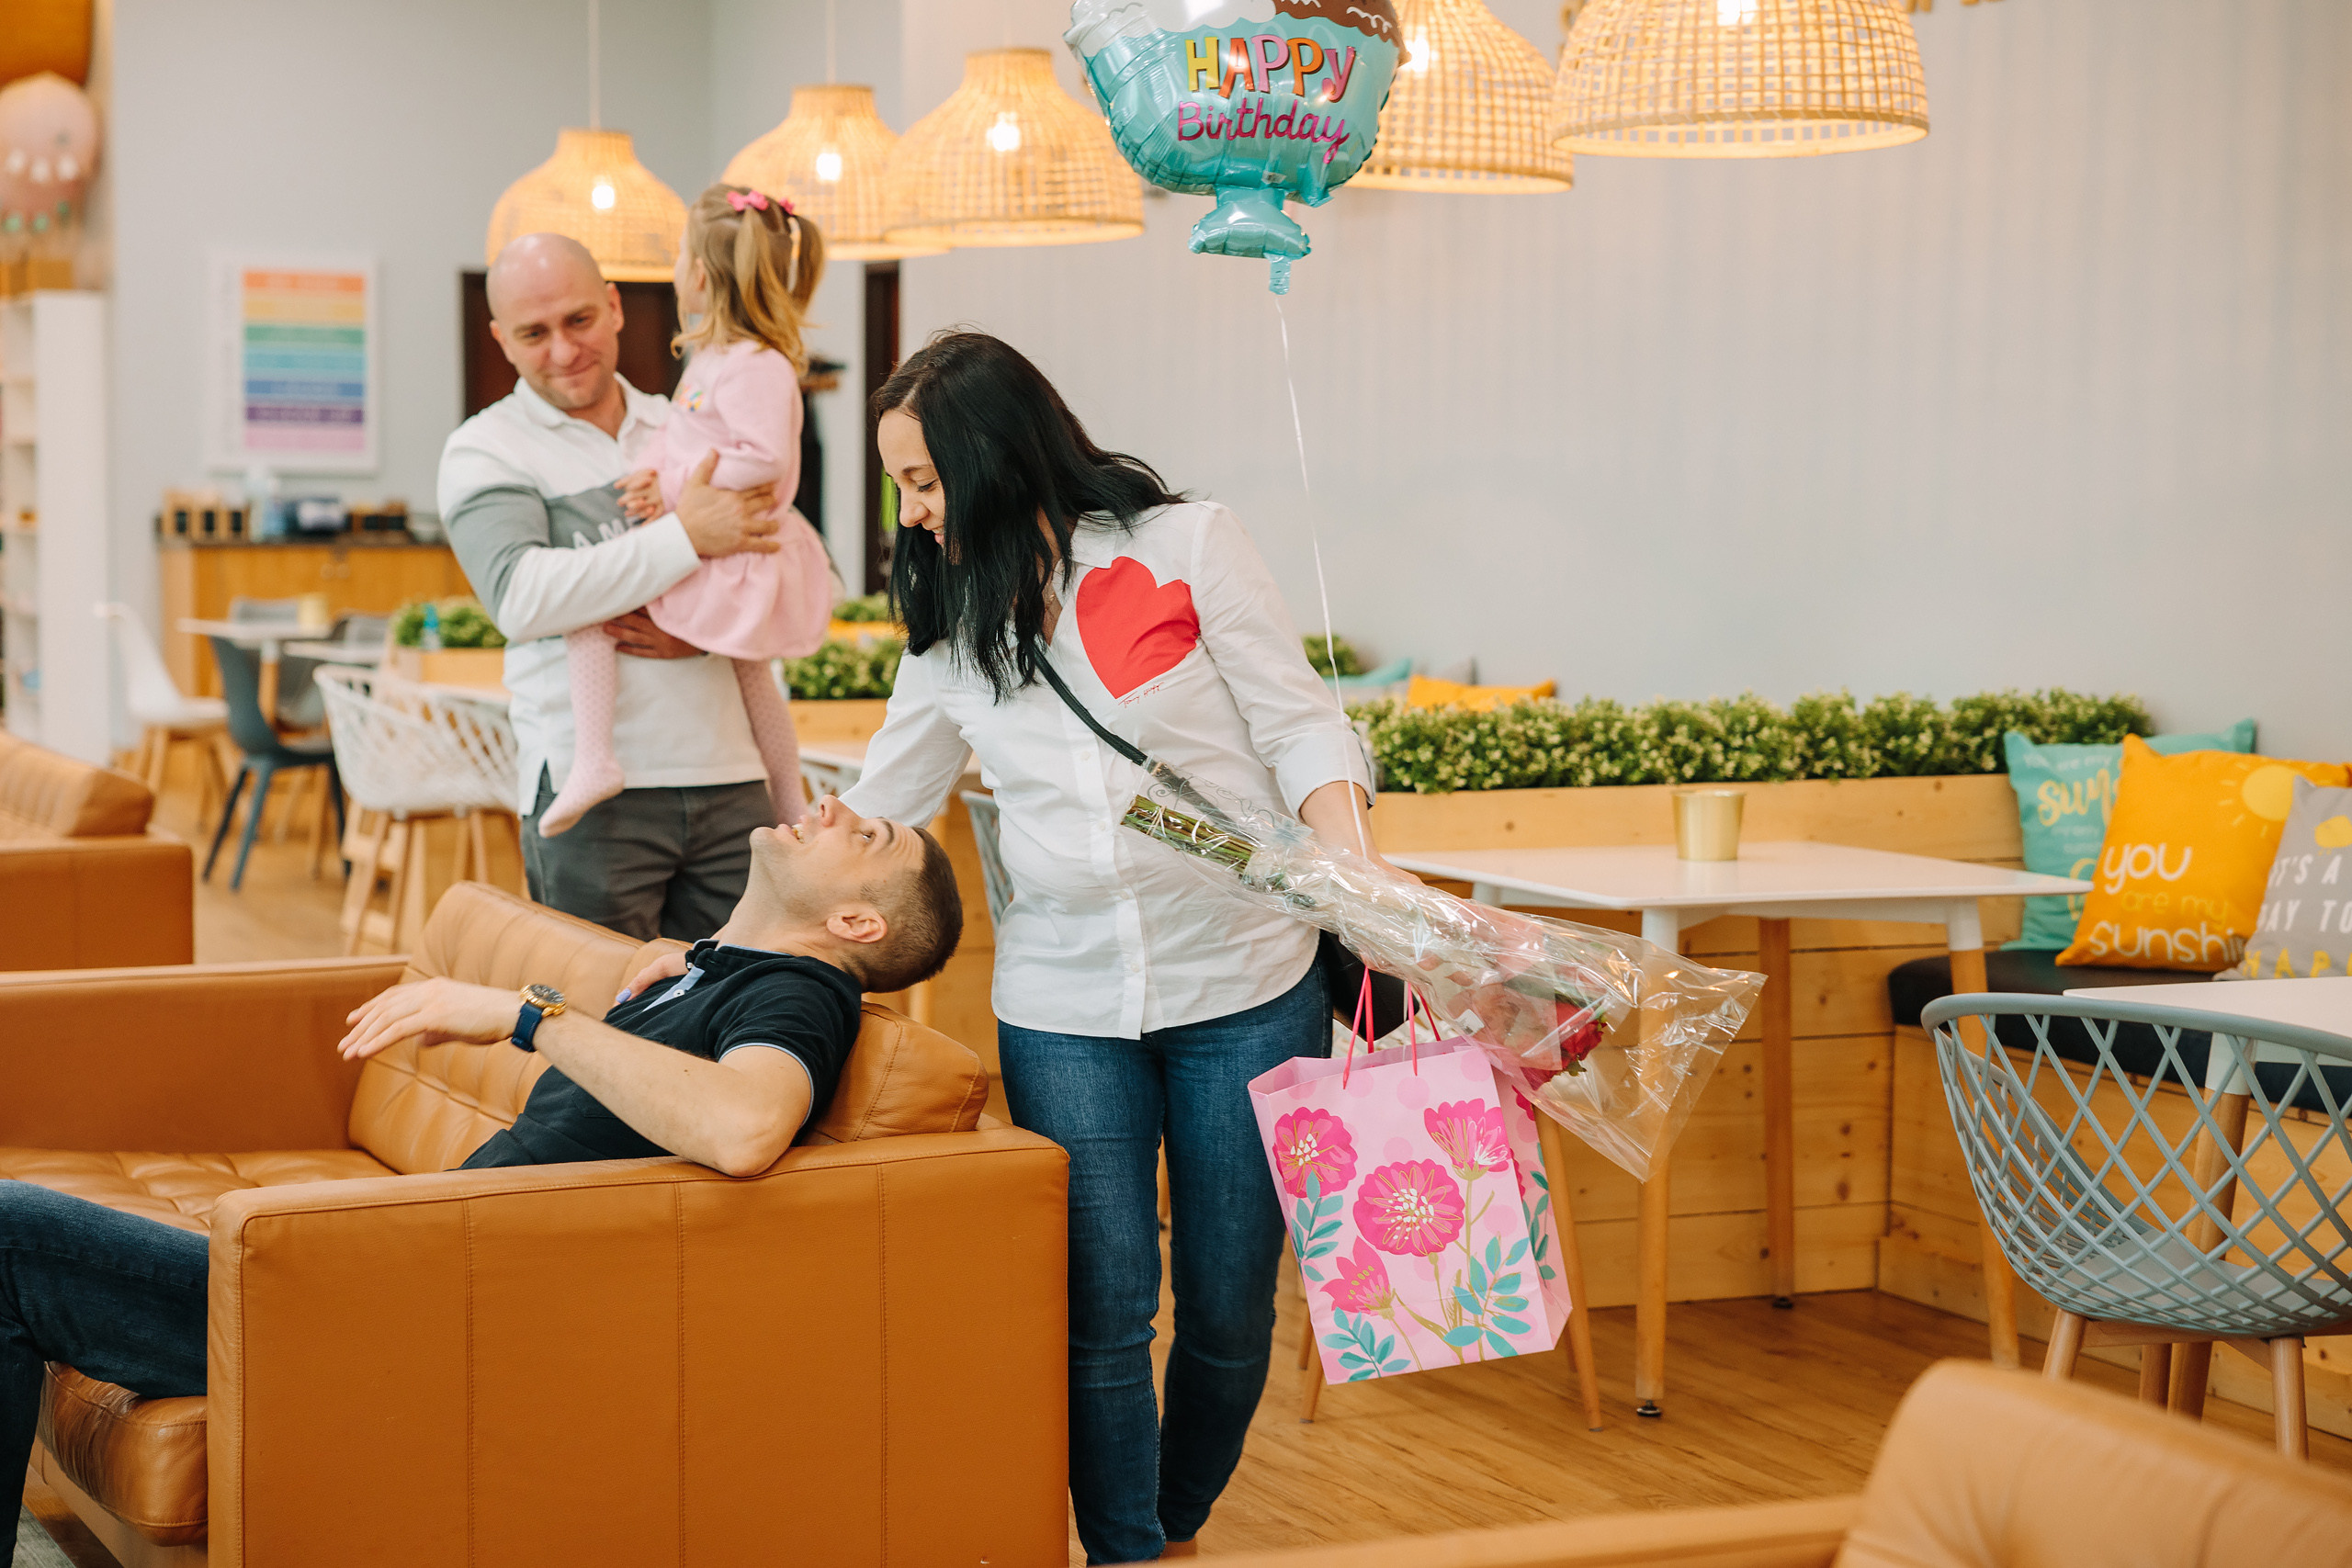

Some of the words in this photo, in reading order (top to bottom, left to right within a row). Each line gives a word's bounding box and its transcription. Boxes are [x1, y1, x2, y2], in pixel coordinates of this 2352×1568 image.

[1177, 96, 1350, 164] Birthday
[2103, 842, 2192, 895] you
[2321, 853, 2342, 885] A
[2121, 890, 2169, 915] are
[2180, 895, 2228, 930] my
